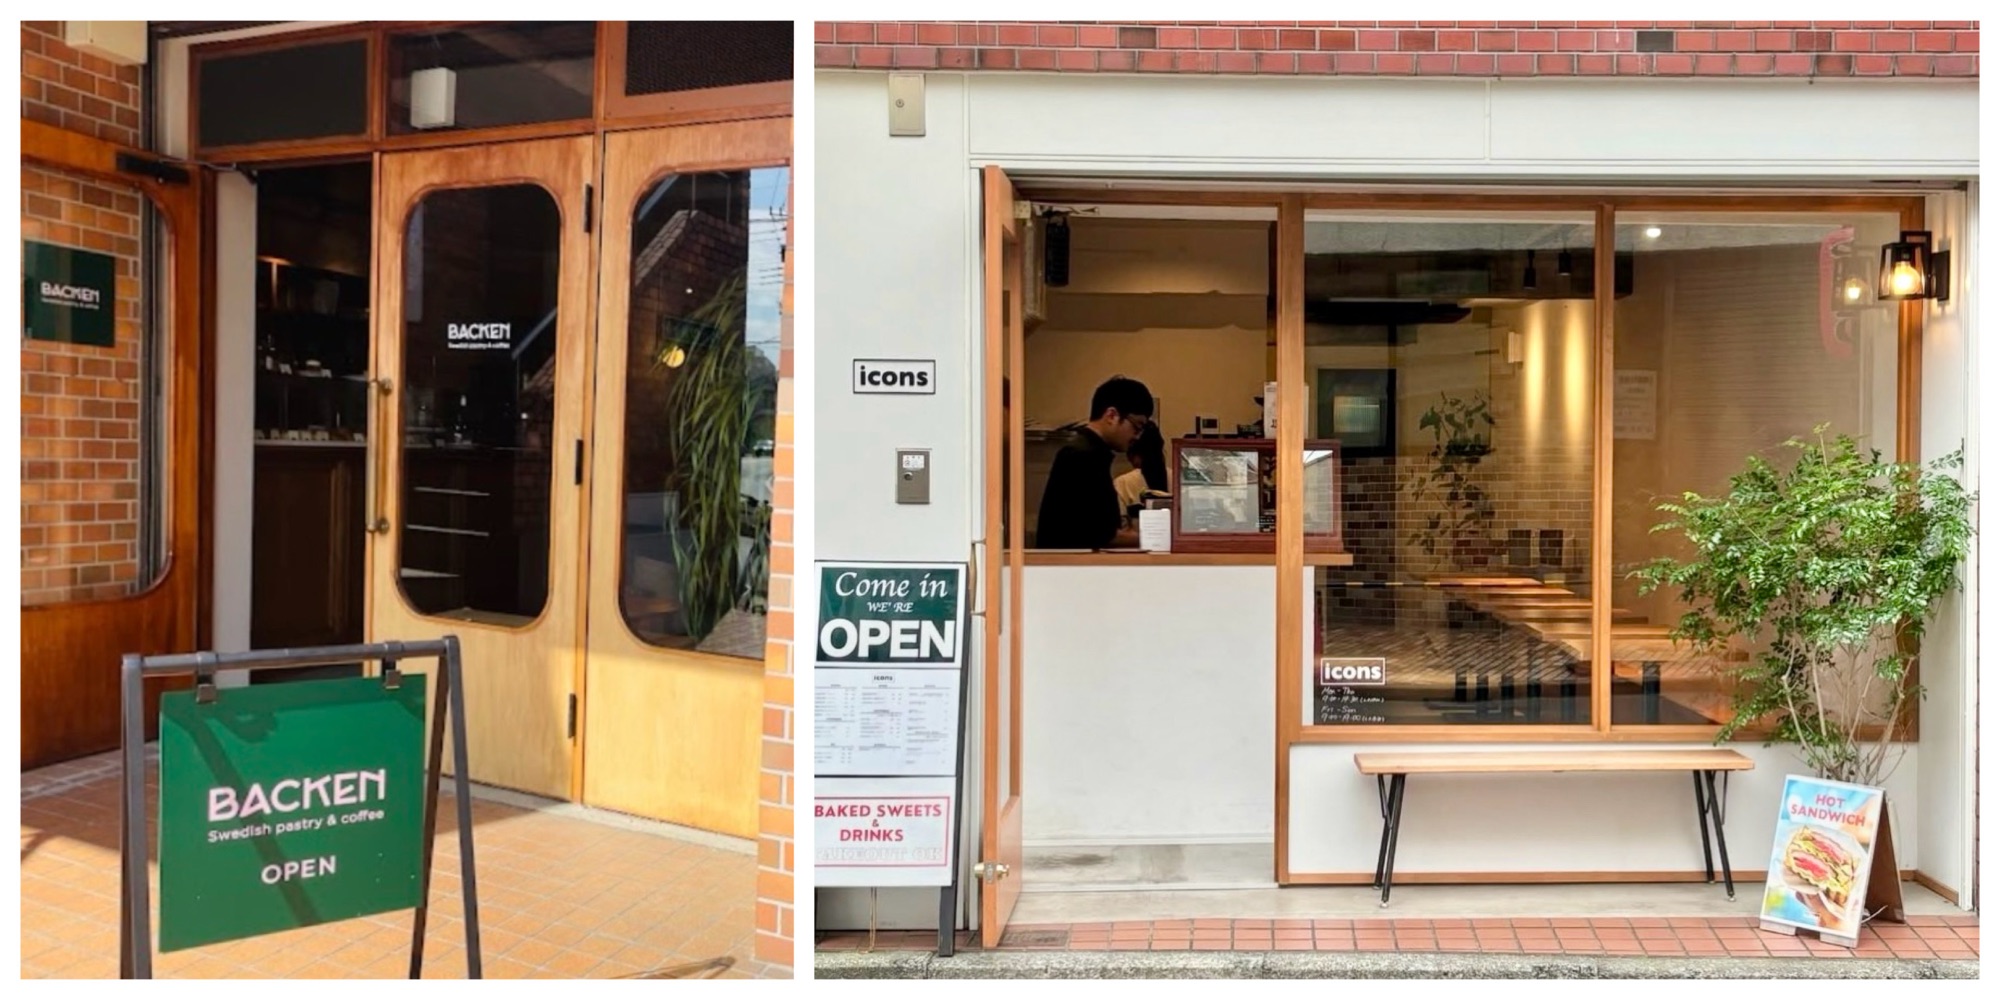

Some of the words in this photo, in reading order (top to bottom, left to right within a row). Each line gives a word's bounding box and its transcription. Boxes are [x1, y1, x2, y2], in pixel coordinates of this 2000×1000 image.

[41, 281, 99, 303] BACKEN
[448, 322, 511, 339] BACKEN
[860, 365, 928, 386] icons
[835, 571, 910, 598] Come
[919, 572, 948, 598] in
[820, 618, 955, 658] OPEN
[1324, 662, 1382, 679] icons
[208, 768, 386, 822] BACKEN
[1815, 794, 1847, 808] HOT
[814, 805, 871, 818] BAKED
[877, 804, 942, 817] SWEETS
[1791, 804, 1866, 827] SANDWICH
[208, 824, 272, 843] Swedish
[275, 817, 323, 836] pastry
[327, 814, 337, 826] &
[341, 809, 385, 824] coffee
[872, 818, 880, 828] &
[840, 829, 904, 842] DRINKS
[261, 855, 337, 884] OPEN
